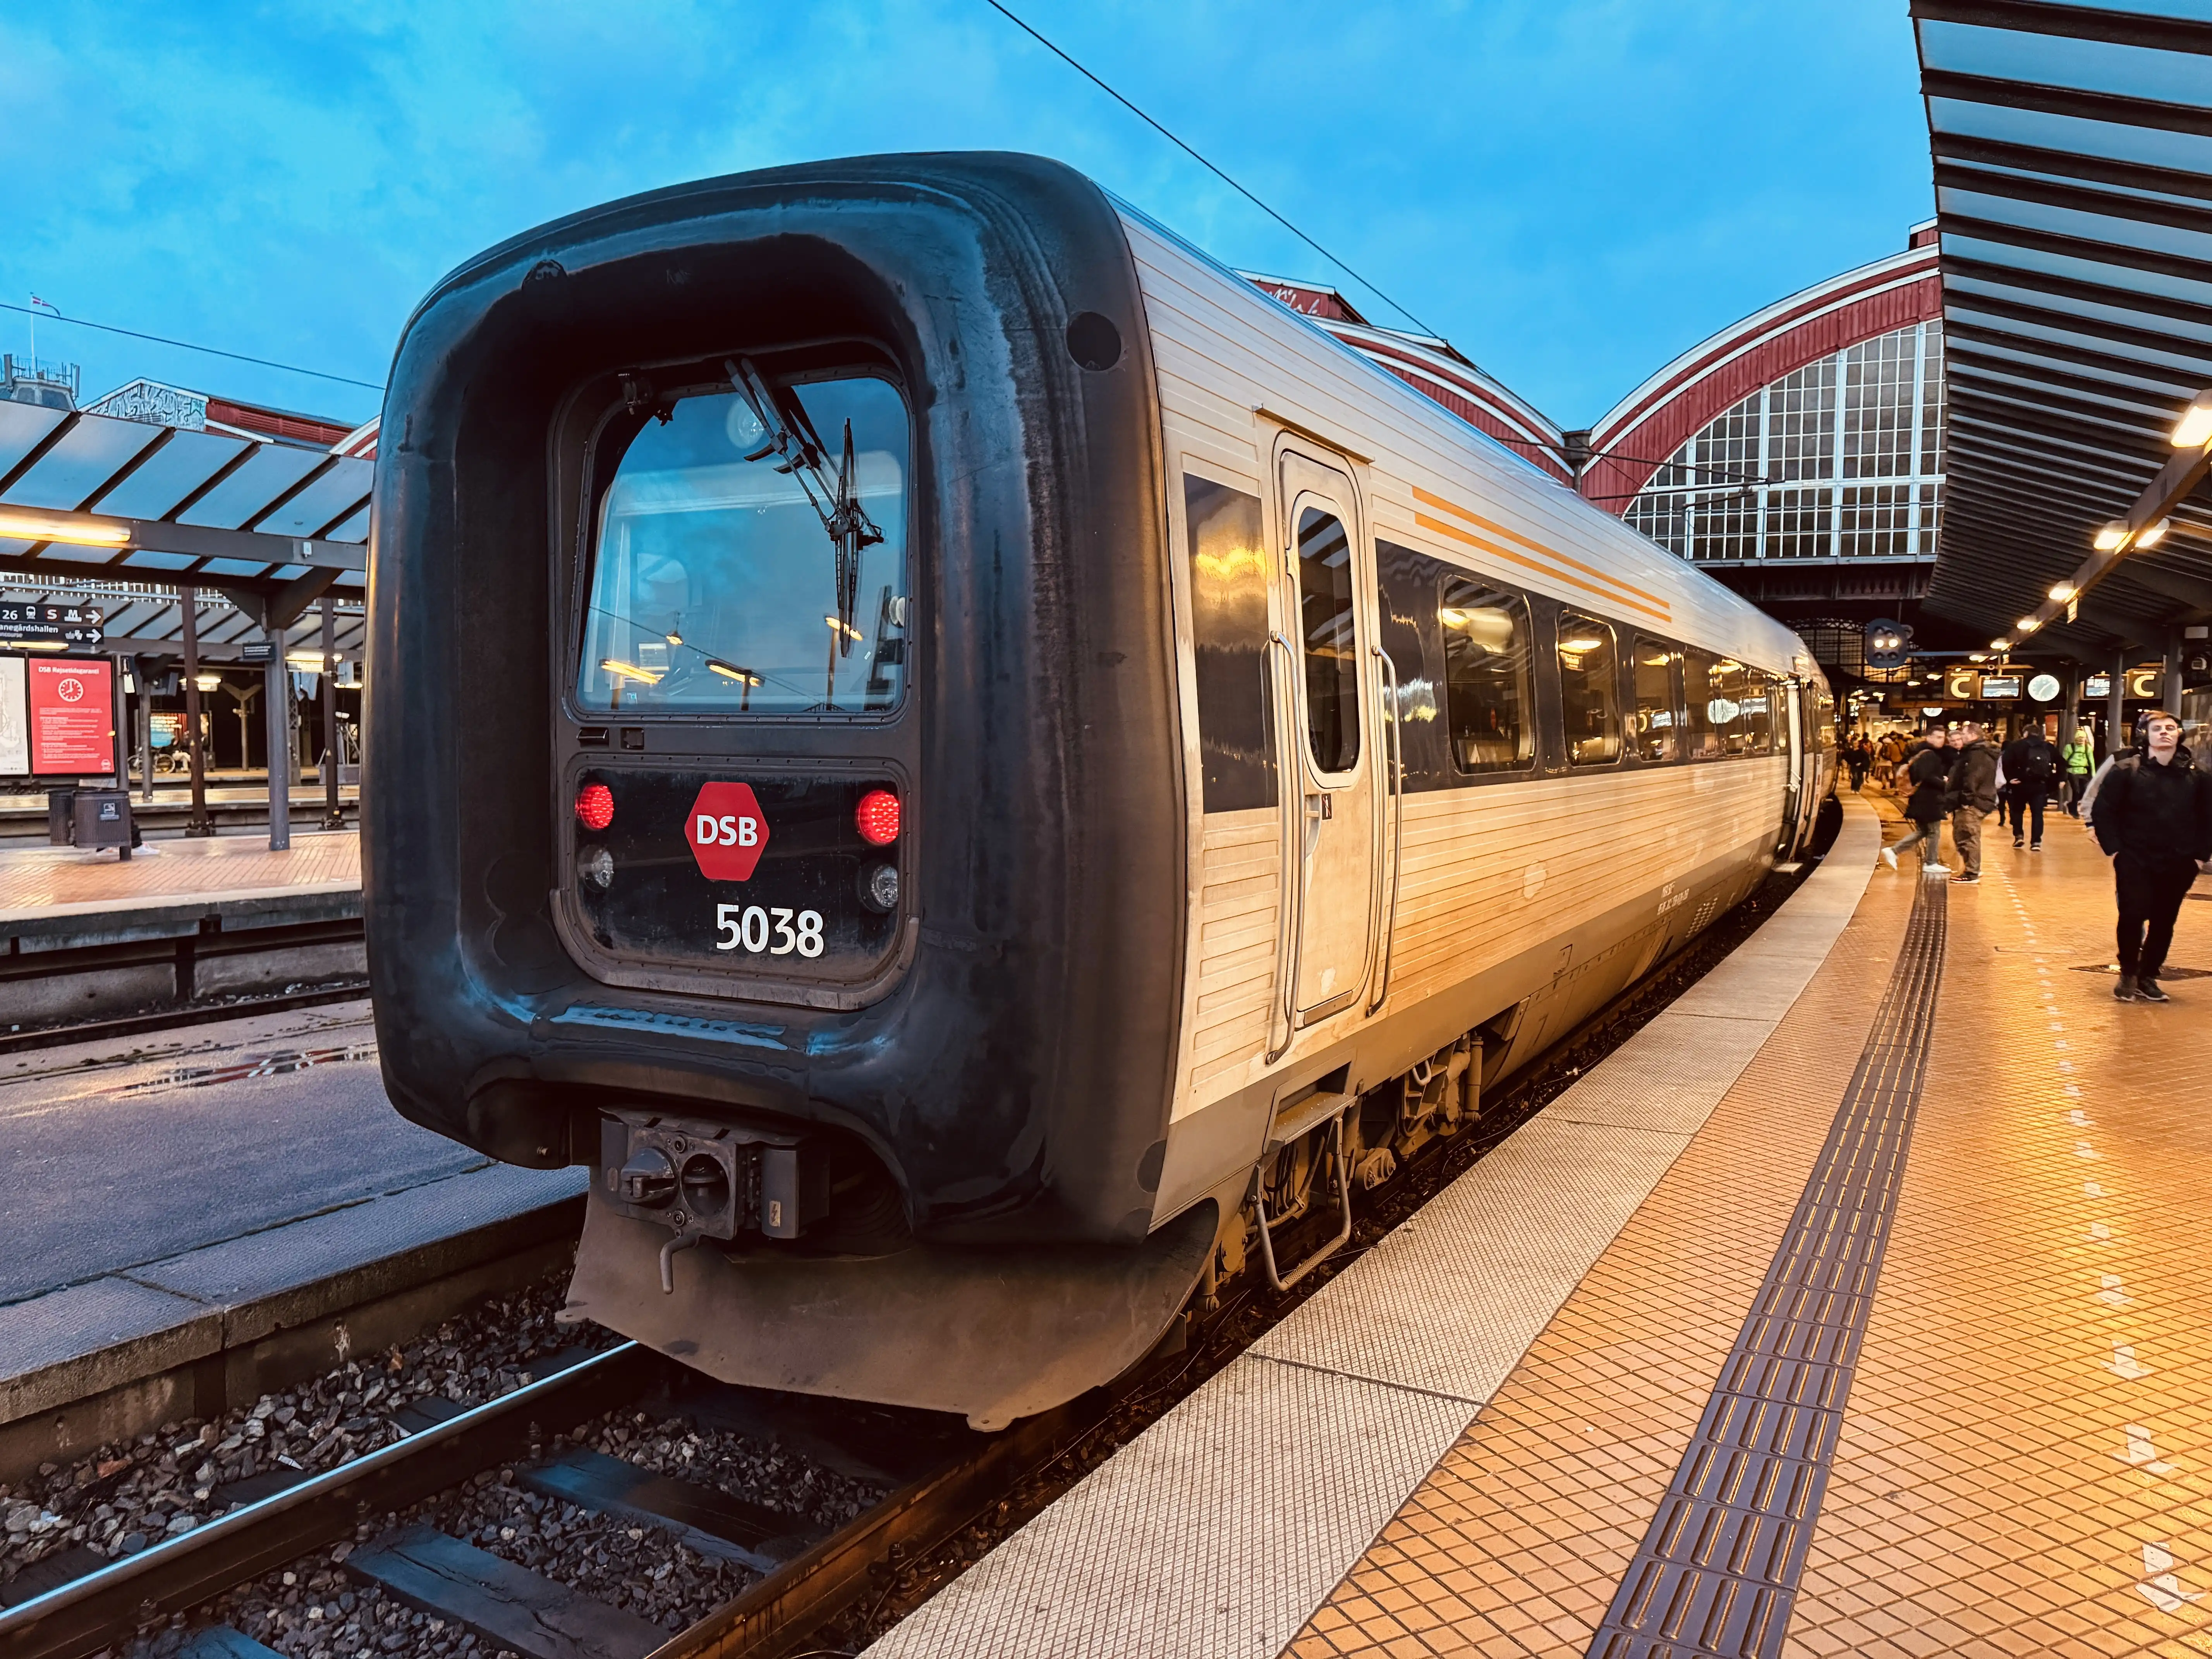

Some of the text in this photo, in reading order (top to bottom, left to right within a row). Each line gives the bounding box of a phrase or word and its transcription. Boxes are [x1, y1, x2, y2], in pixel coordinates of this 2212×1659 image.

[2, 610, 18, 620] 26
[47, 609, 57, 620] S
[1951, 677, 1970, 698] C
[2133, 675, 2155, 697] C
[697, 814, 758, 847] DSB
[716, 903, 824, 958] 5038
